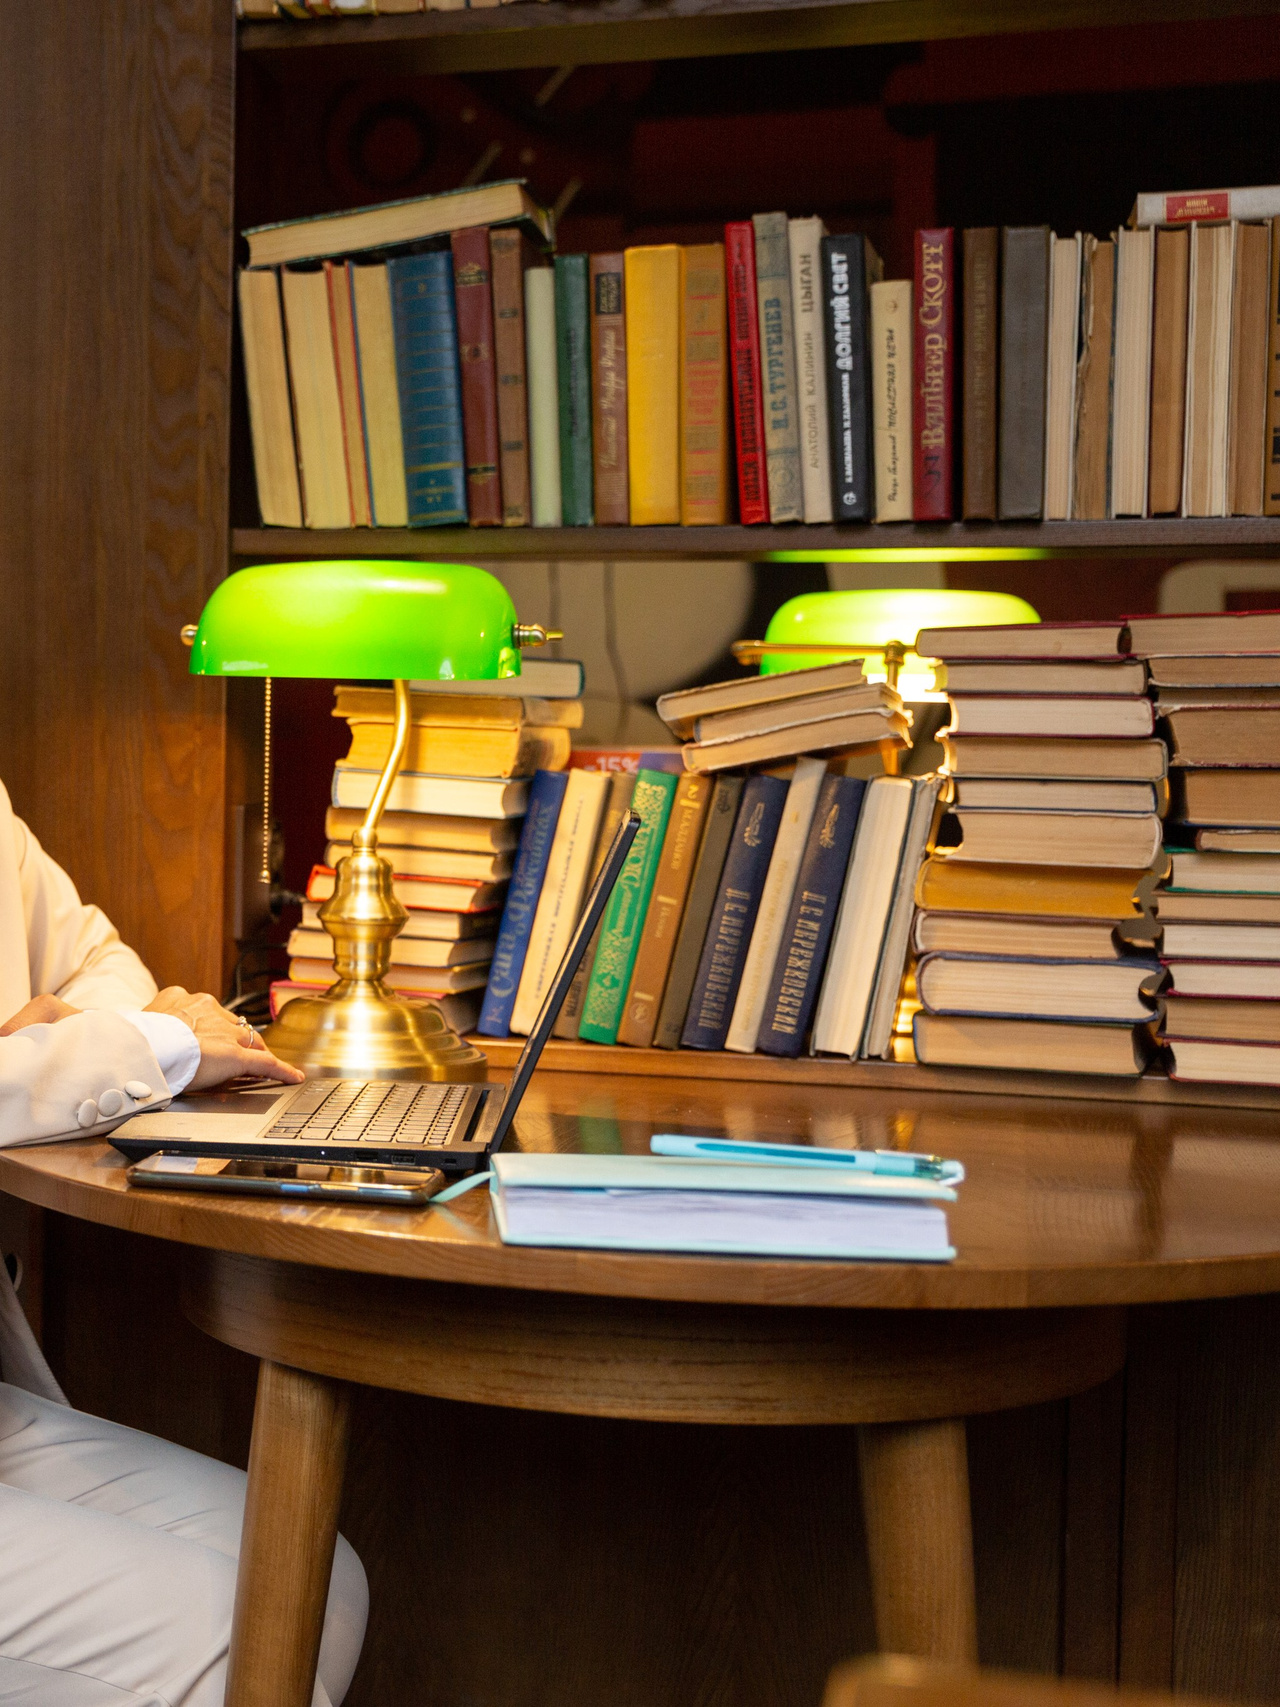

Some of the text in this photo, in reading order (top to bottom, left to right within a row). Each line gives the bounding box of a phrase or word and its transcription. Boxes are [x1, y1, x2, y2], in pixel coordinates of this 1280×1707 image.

[831, 252, 849, 294] СВЕТ
[800, 254, 820, 469] АНАТОЛИЙ КАЛИНИН ЦЫГАН
[830, 295, 853, 371] ДОЛГИЙ
[686, 784, 700, 801] 2
[490, 933, 517, 998] Сага
[771, 918, 821, 1035] МЕРЕЖКОВСКИЙ
